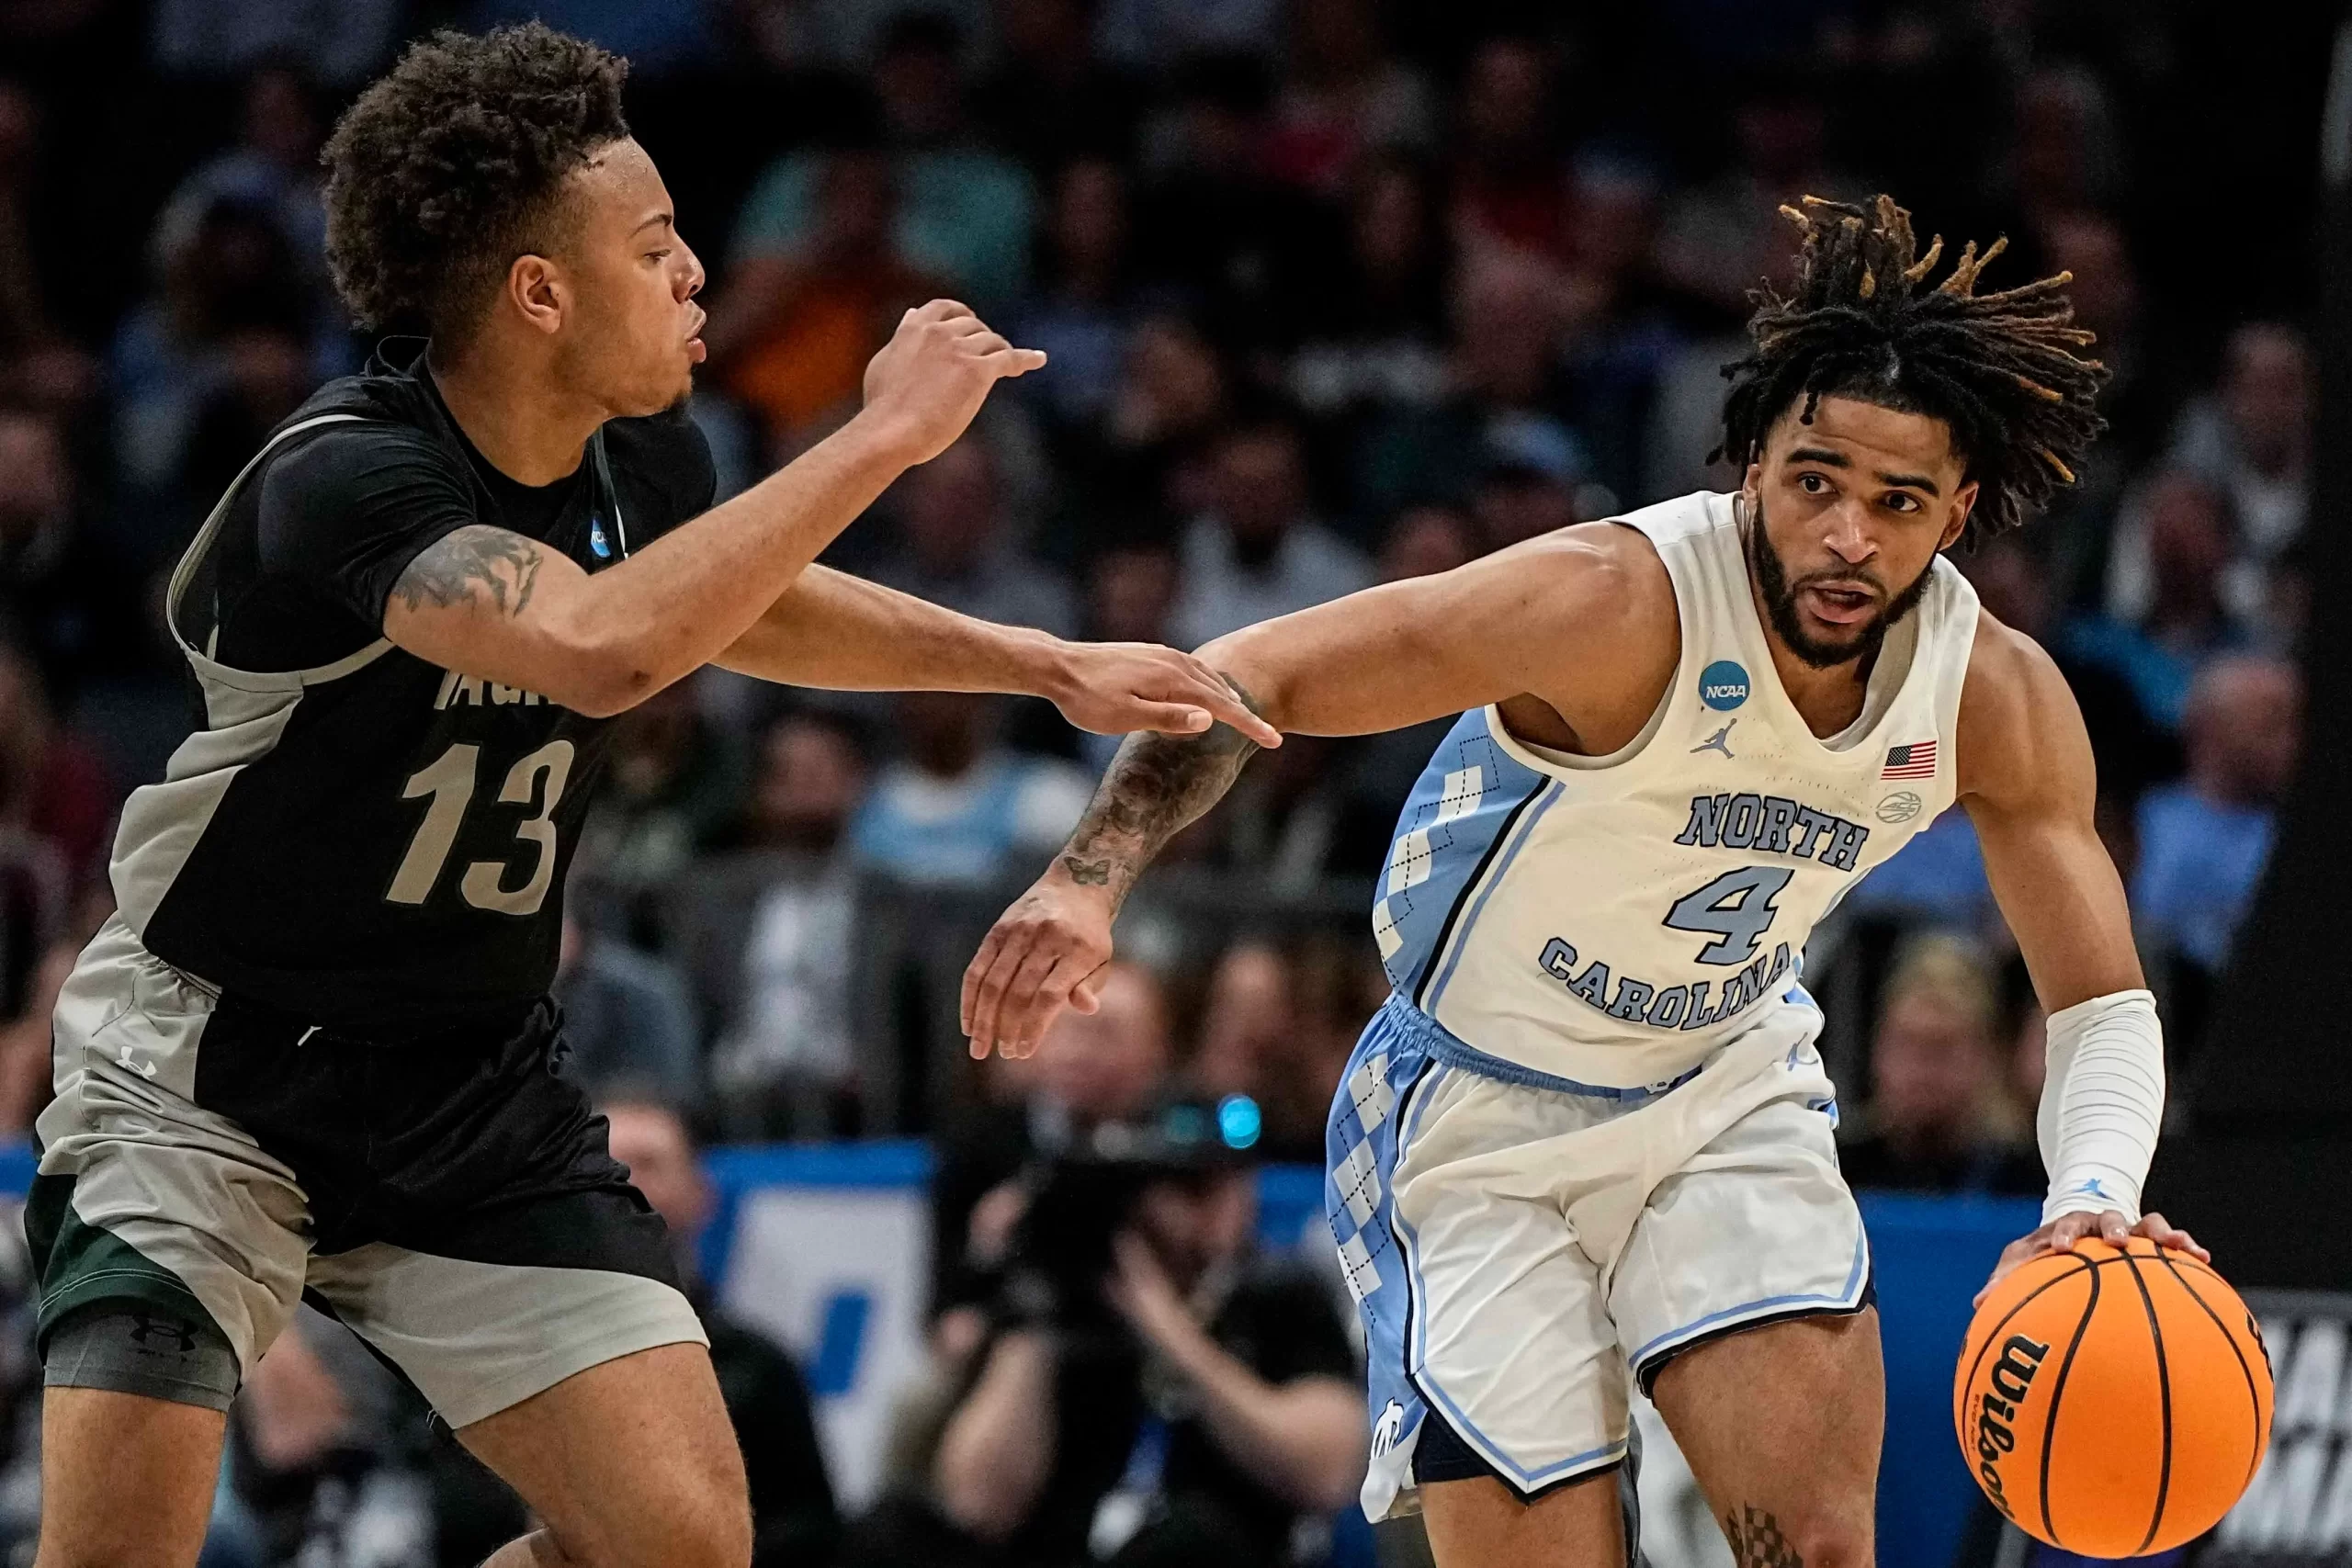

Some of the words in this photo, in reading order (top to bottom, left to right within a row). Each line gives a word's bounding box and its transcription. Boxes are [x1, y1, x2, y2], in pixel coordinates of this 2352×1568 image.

[1705, 684, 1746, 699] NCAA
[386, 739, 575, 916] 13
[1674, 792, 1870, 872] NORTH
[1661, 865, 1795, 966] 4
[1538, 937, 1792, 1031] CAROLINA
